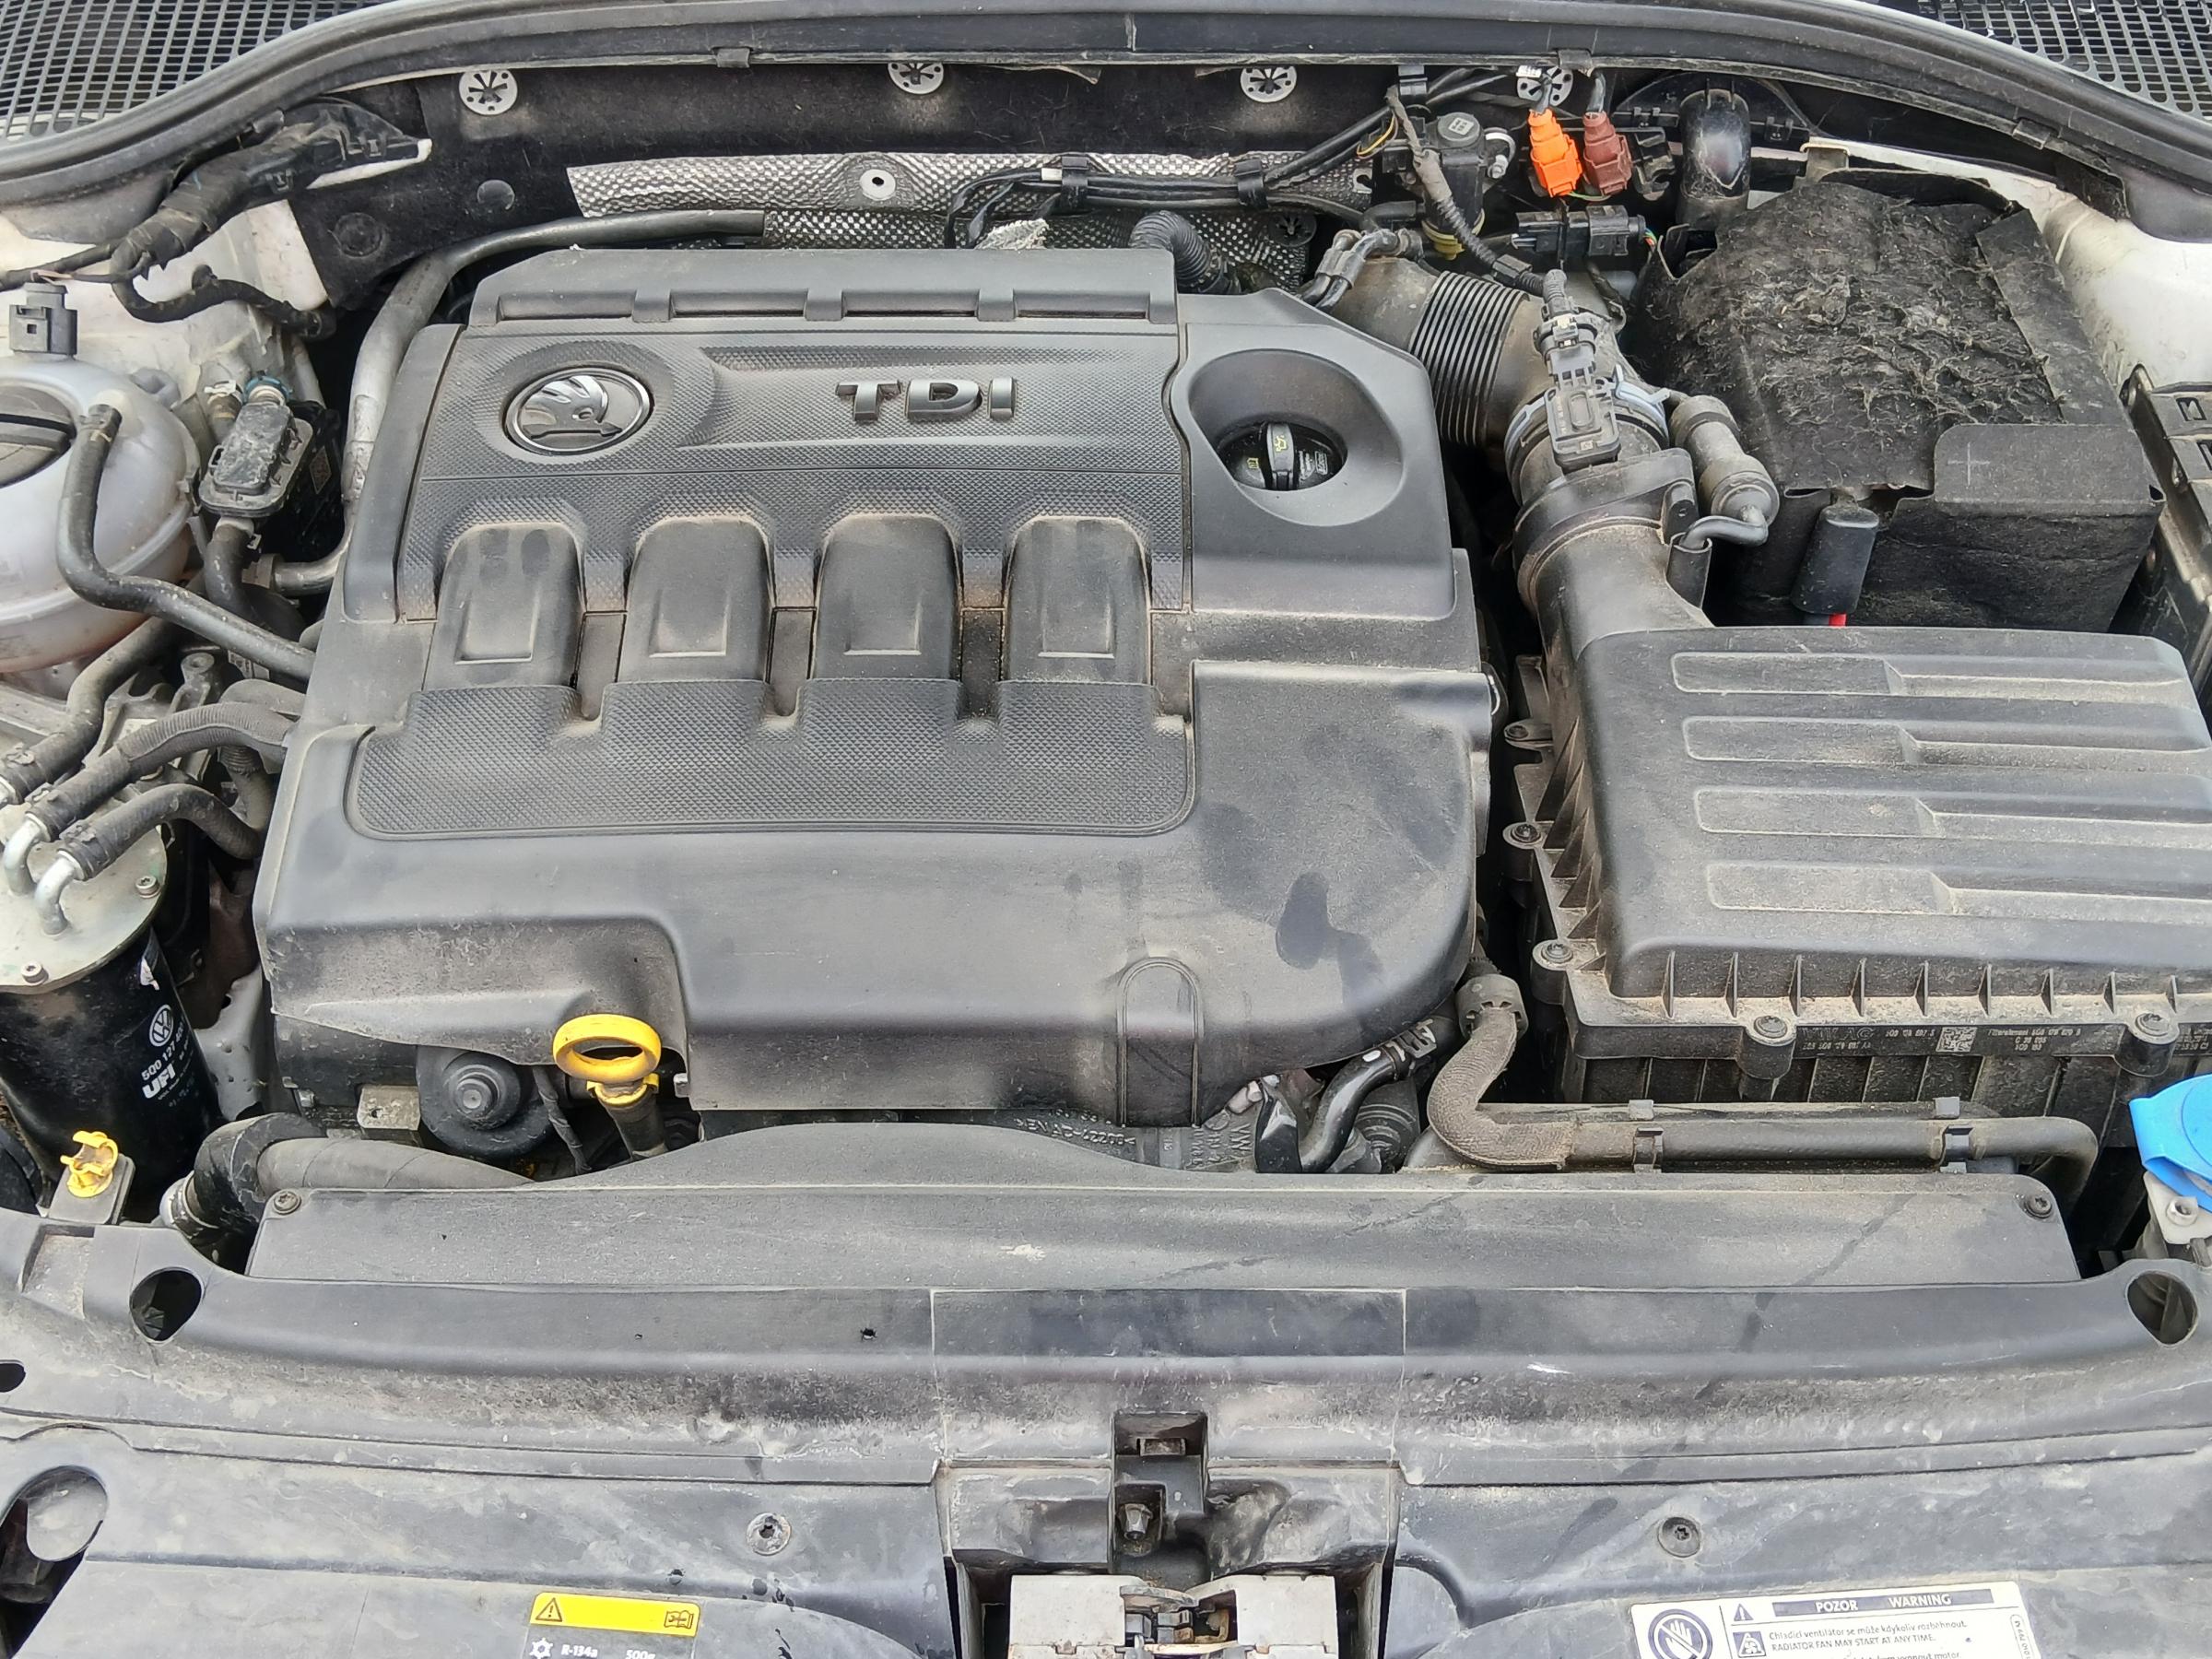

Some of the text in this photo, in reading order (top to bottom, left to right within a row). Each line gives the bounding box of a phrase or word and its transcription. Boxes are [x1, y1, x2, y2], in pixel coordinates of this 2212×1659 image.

[835, 377, 1017, 422] TDI
[142, 1063, 176, 1099] UFI
[1816, 1594, 1952, 1613] POZOR WARNING
[1846, 1628, 1854, 1636] se
[1881, 1622, 1915, 1634] kdykoliv
[561, 1644, 598, 1658] R-134a
[1771, 1641, 1814, 1652] RADIATOR
[1816, 1640, 1833, 1649] FAN
[1834, 1639, 1853, 1648] MAY
[1854, 1637, 1879, 1646] START
[1882, 1636, 1891, 1644] AT
[1894, 1635, 1911, 1643] ANY
